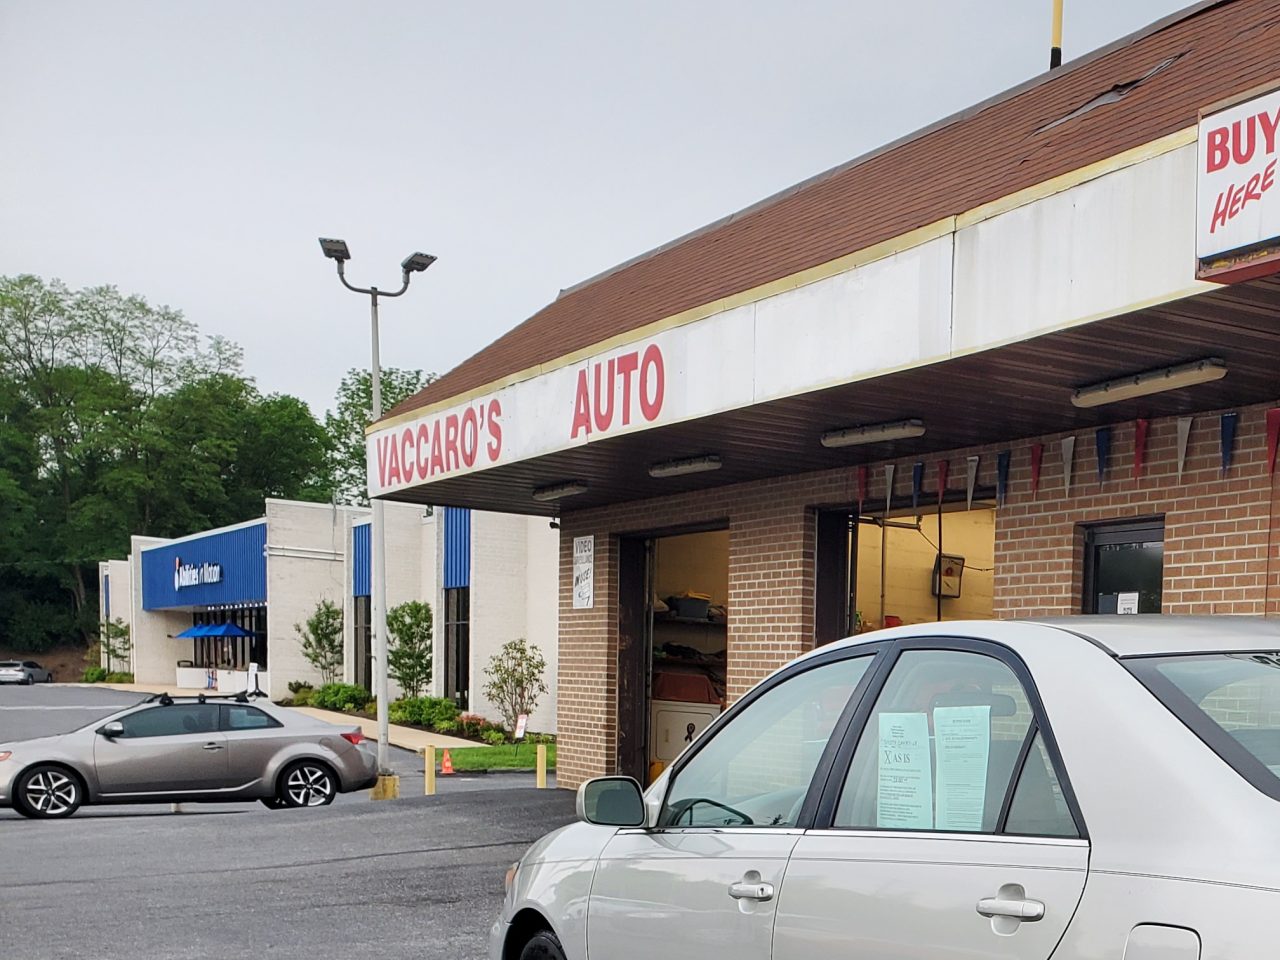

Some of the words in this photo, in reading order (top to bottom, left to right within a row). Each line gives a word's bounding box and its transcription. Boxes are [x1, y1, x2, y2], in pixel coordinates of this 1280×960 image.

[1209, 158, 1278, 234] HERE
[376, 398, 503, 488] VACCARO'S
[570, 343, 665, 440] AUTO
